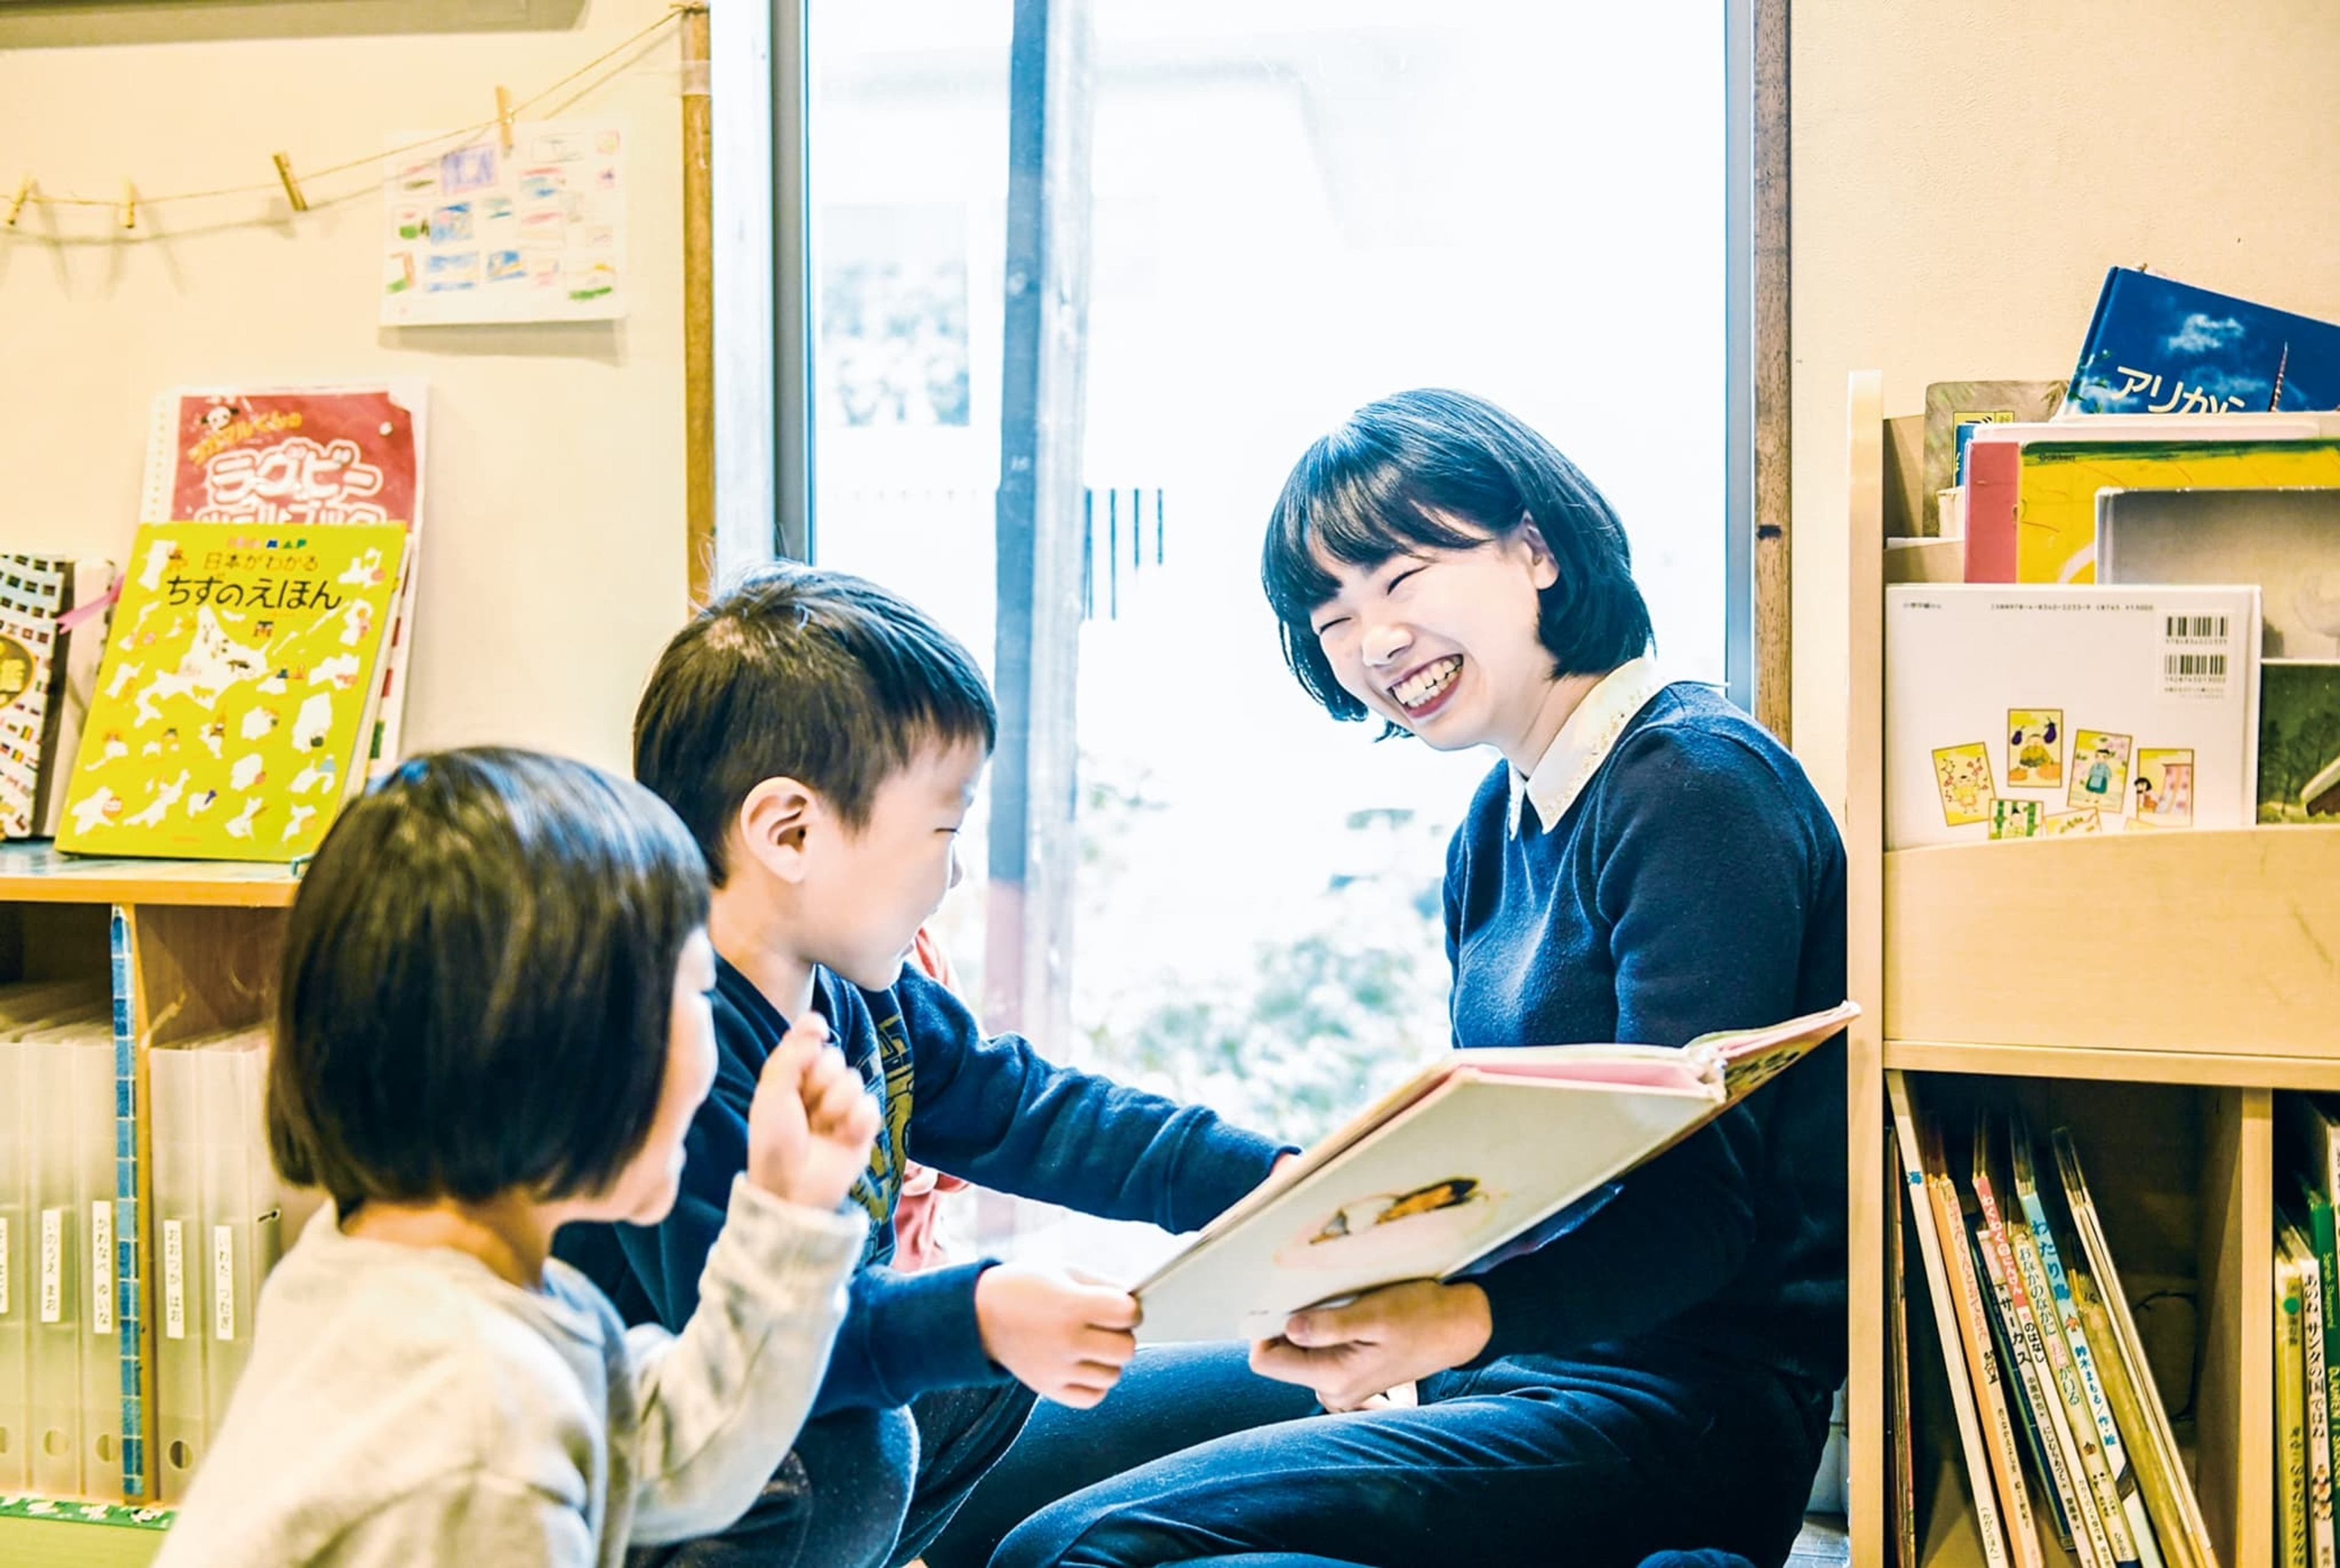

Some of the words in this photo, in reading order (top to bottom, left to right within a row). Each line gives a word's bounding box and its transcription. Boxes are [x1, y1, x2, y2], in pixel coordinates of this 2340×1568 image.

[210, 440, 380, 505] ラグビー
[204, 552, 319, 572] 日本がわかる
[1999, 1297, 2032, 1365] サーカス
